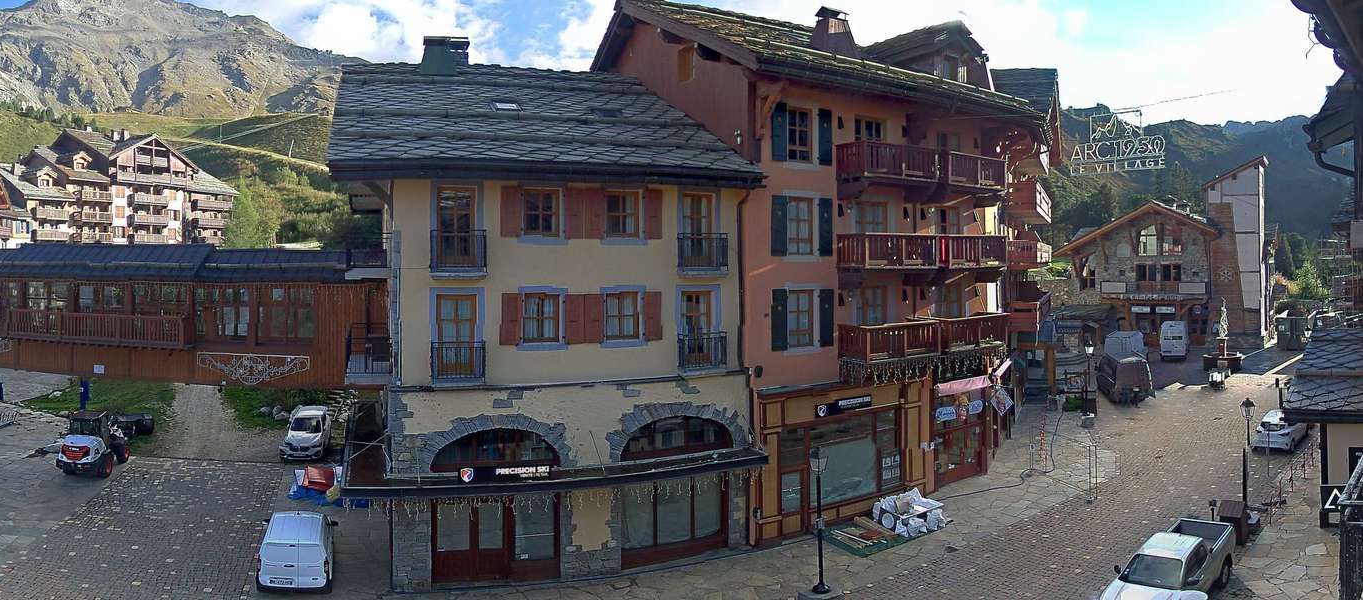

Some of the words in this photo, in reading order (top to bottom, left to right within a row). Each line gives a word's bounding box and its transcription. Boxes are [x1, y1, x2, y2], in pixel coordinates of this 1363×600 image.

[1070, 141, 1111, 162] ARC
[1113, 135, 1166, 158] 1950
[1070, 164, 1085, 175] LE
[496, 467, 536, 475] PRECISION
